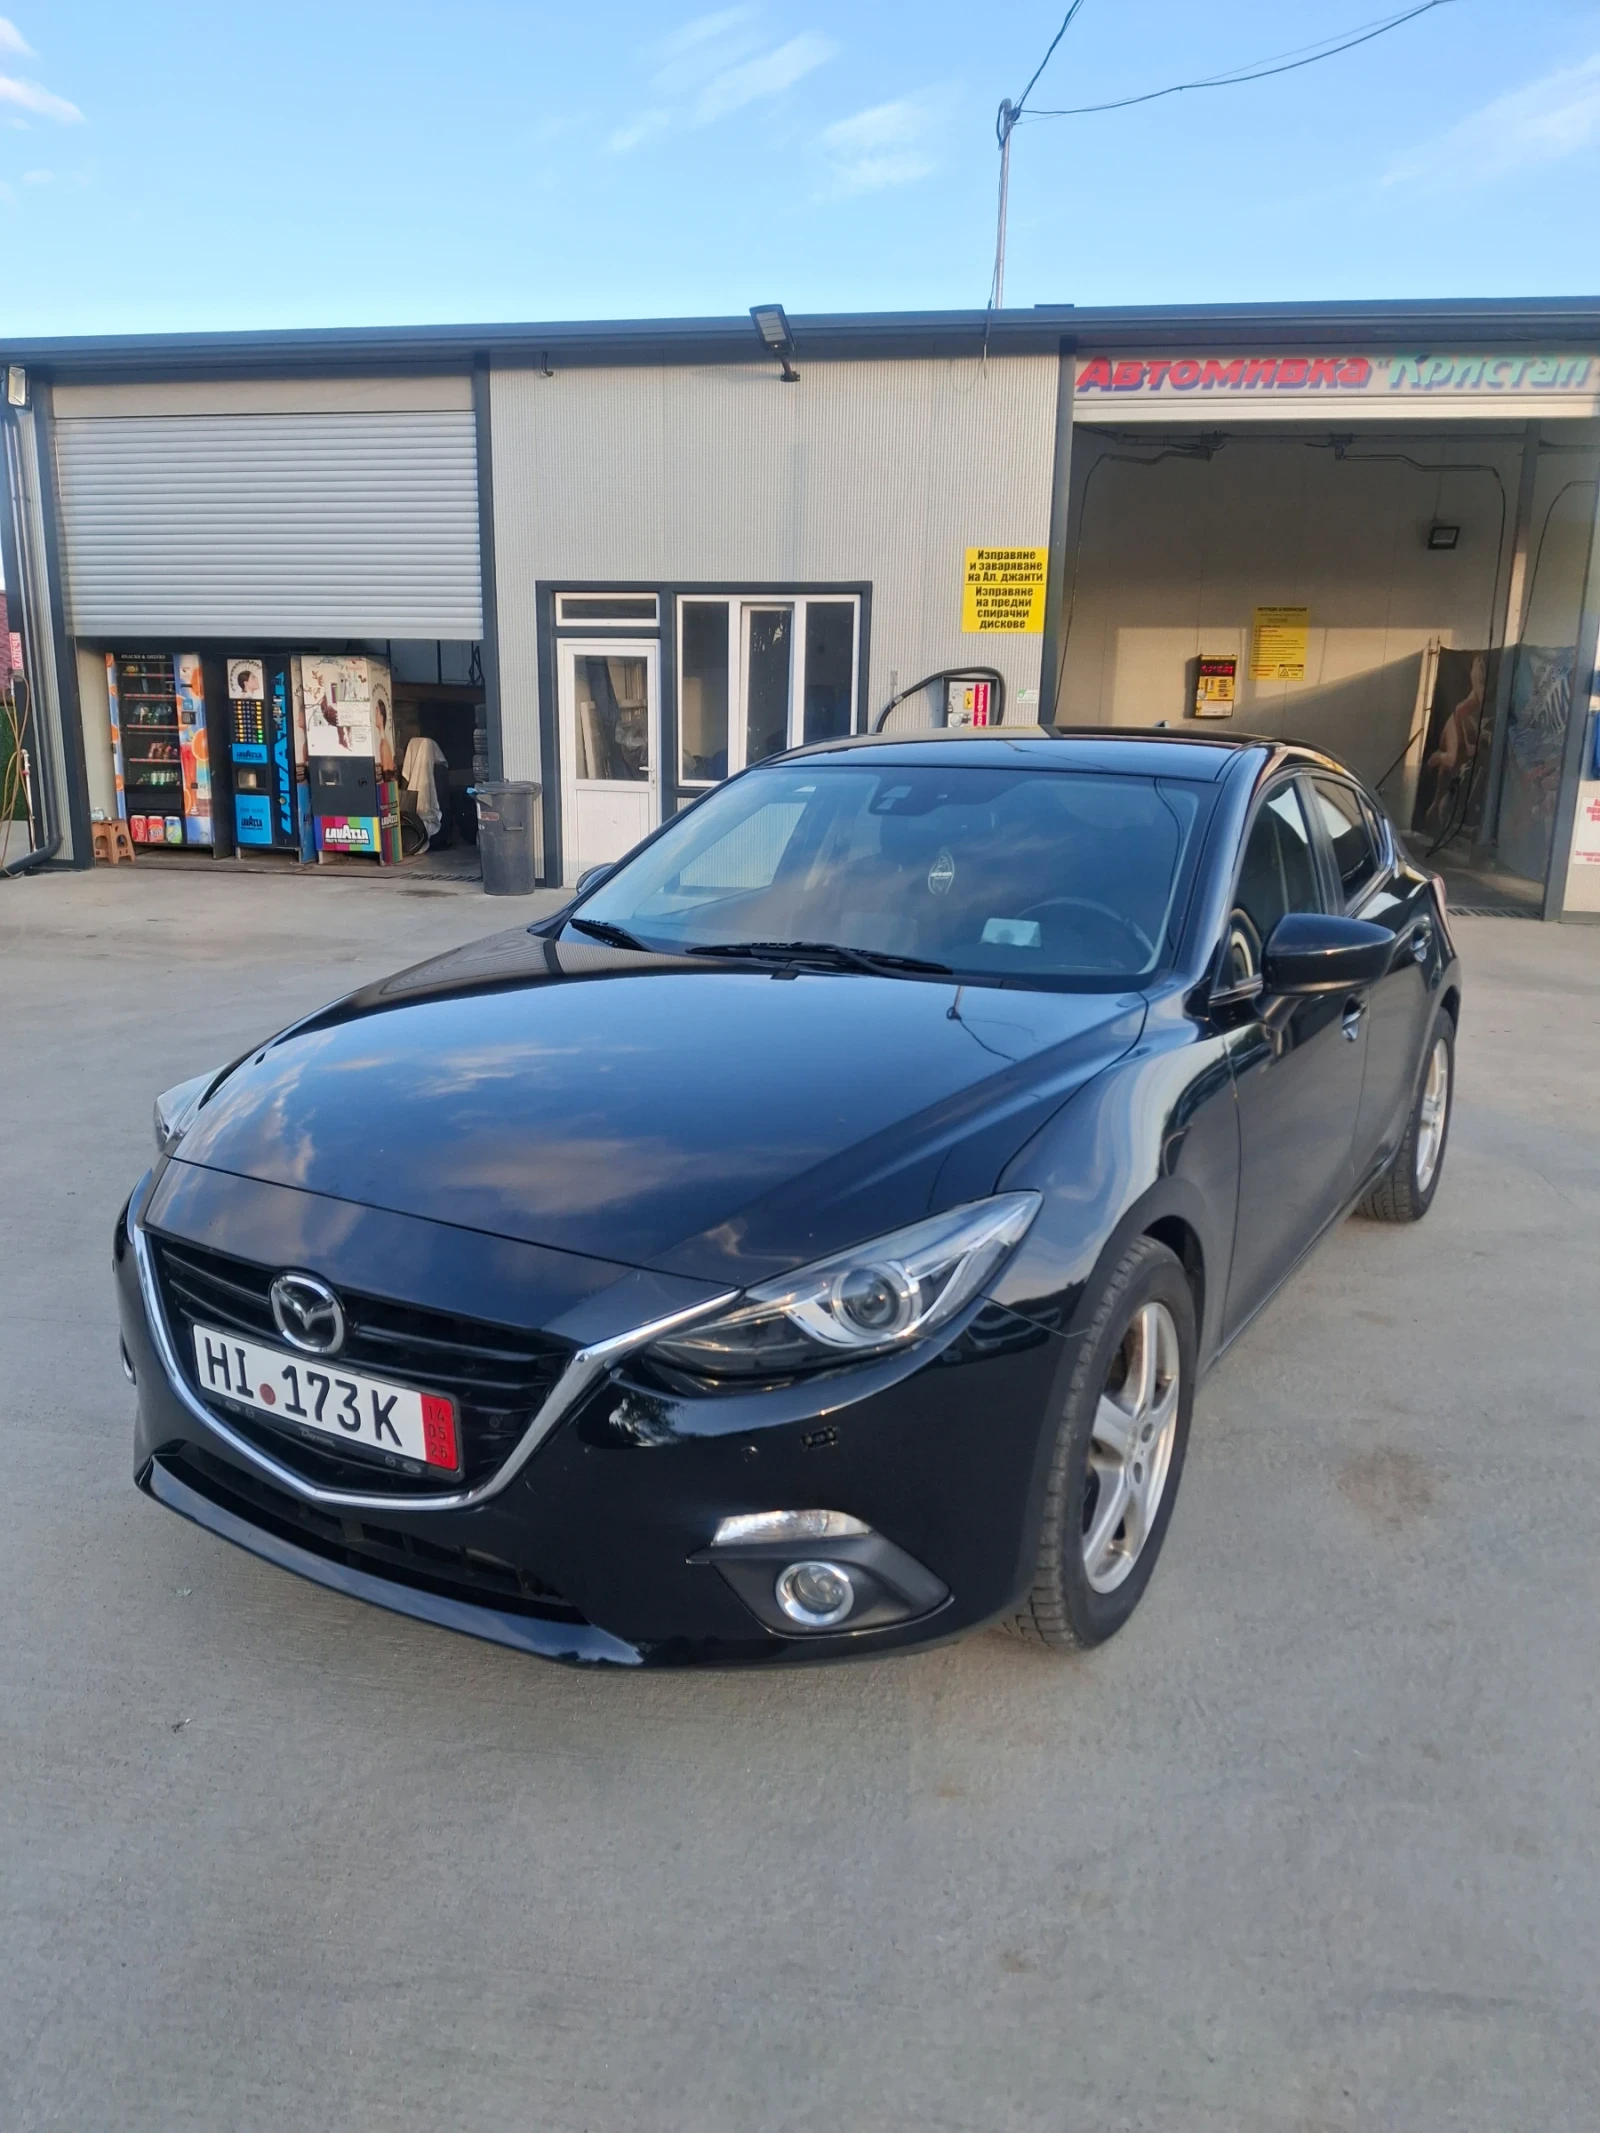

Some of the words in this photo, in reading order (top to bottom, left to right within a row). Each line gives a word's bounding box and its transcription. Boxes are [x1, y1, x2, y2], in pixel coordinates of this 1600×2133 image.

[977, 549, 1036, 561] Изправяне
[969, 563, 976, 571] и
[978, 562, 1043, 572] заваряване
[968, 573, 981, 582] на
[982, 571, 998, 583] Ал.
[1000, 572, 1043, 583] джанти
[975, 586, 1034, 597] Изправяне
[976, 599, 988, 607] на
[991, 598, 1032, 608] предни
[977, 609, 1029, 619] спирачни
[979, 620, 1026, 630] дискове
[325, 824, 369, 839] LAVAZZA
[204, 1336, 255, 1399] HI
[281, 1364, 361, 1432] 173
[428, 1405, 445, 1422] 14
[428, 1423, 447, 1441] 05
[430, 1442, 448, 1459] 26
